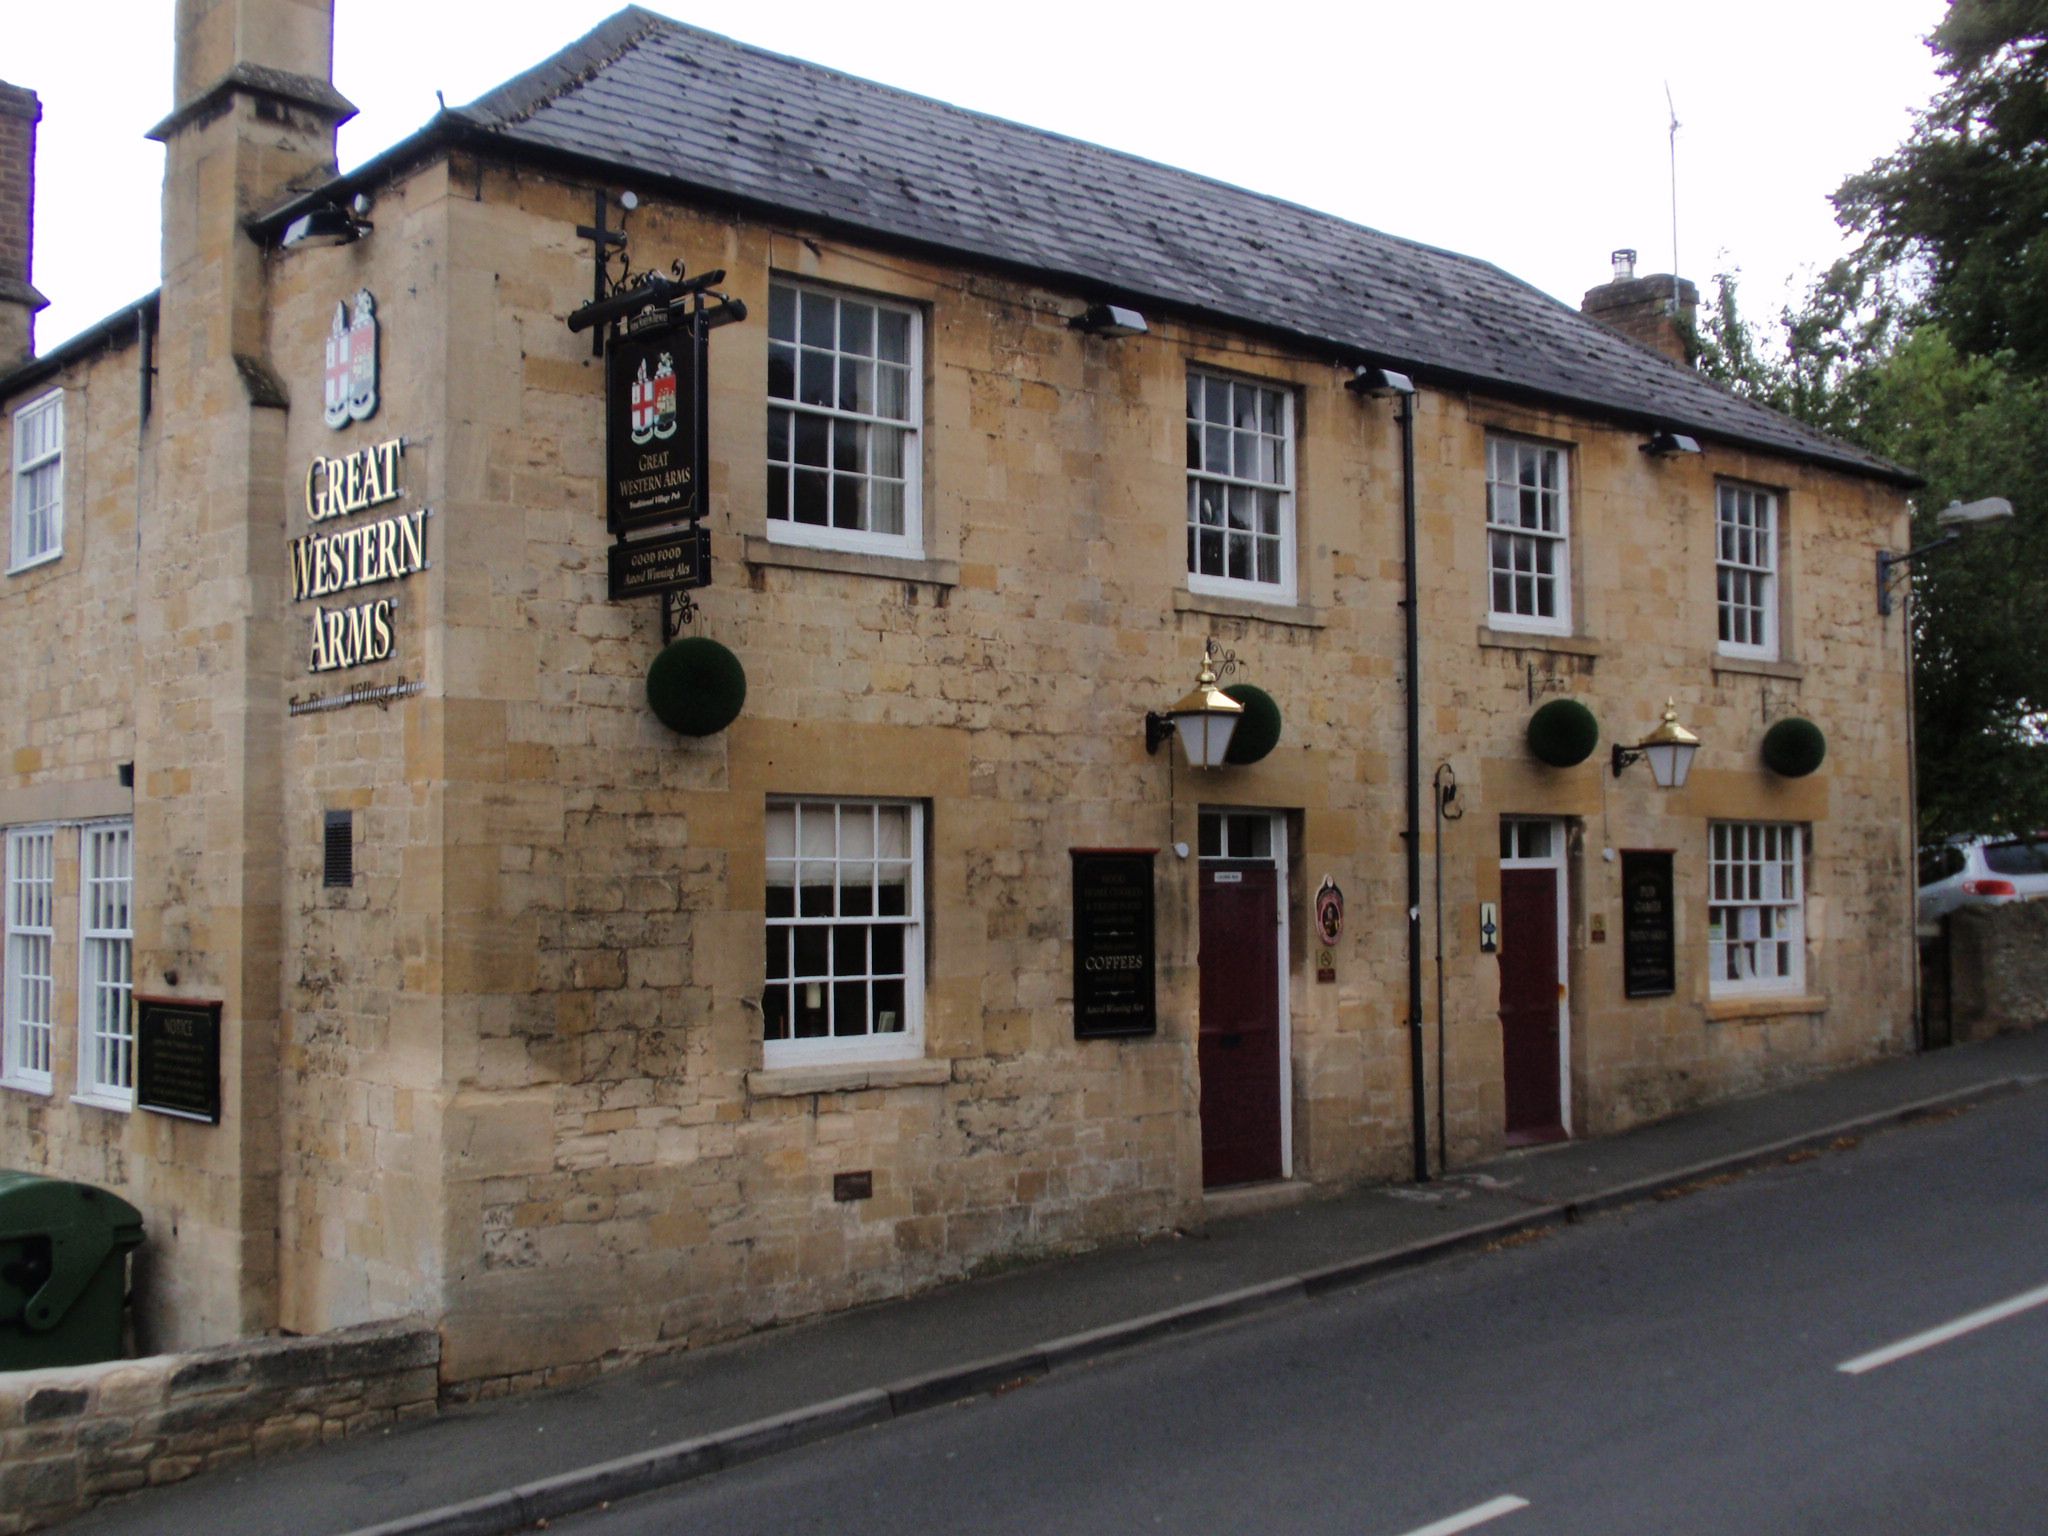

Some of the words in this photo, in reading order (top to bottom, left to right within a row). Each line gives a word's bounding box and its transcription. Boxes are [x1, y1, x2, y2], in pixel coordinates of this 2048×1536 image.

[638, 450, 669, 472] GREAT
[305, 438, 402, 522] GREAT
[619, 473, 662, 497] WESTERN
[663, 466, 691, 487] ARMS
[288, 509, 427, 601] WESTERN
[631, 551, 656, 567] GOOD
[657, 546, 682, 561] FOOD
[308, 600, 392, 673] ARMS
[1085, 955, 1143, 971] COFFEES
[164, 1018, 194, 1037] NOTICE
